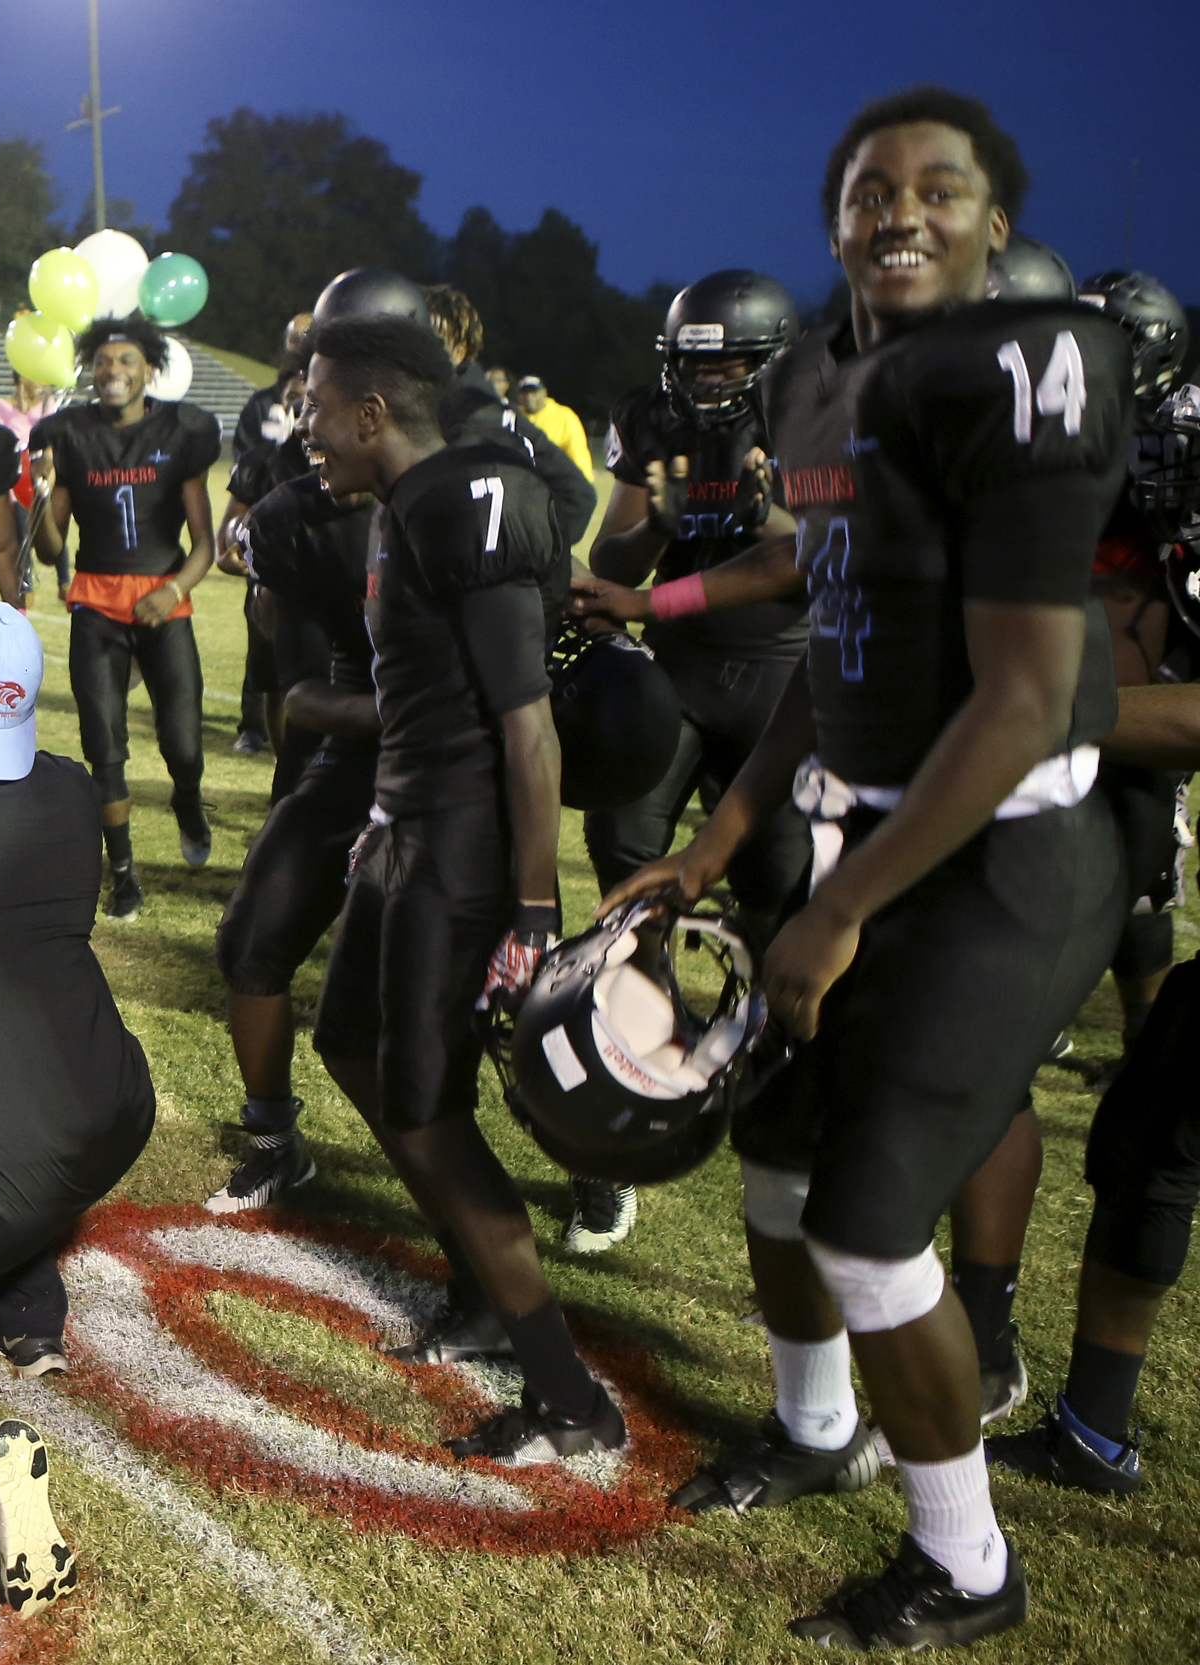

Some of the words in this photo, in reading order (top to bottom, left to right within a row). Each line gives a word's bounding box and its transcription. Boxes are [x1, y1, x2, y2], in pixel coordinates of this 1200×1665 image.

[997, 330, 1087, 443] 14
[86, 466, 157, 487] PANTHERS
[114, 484, 138, 550] 1
[469, 476, 504, 552] 7
